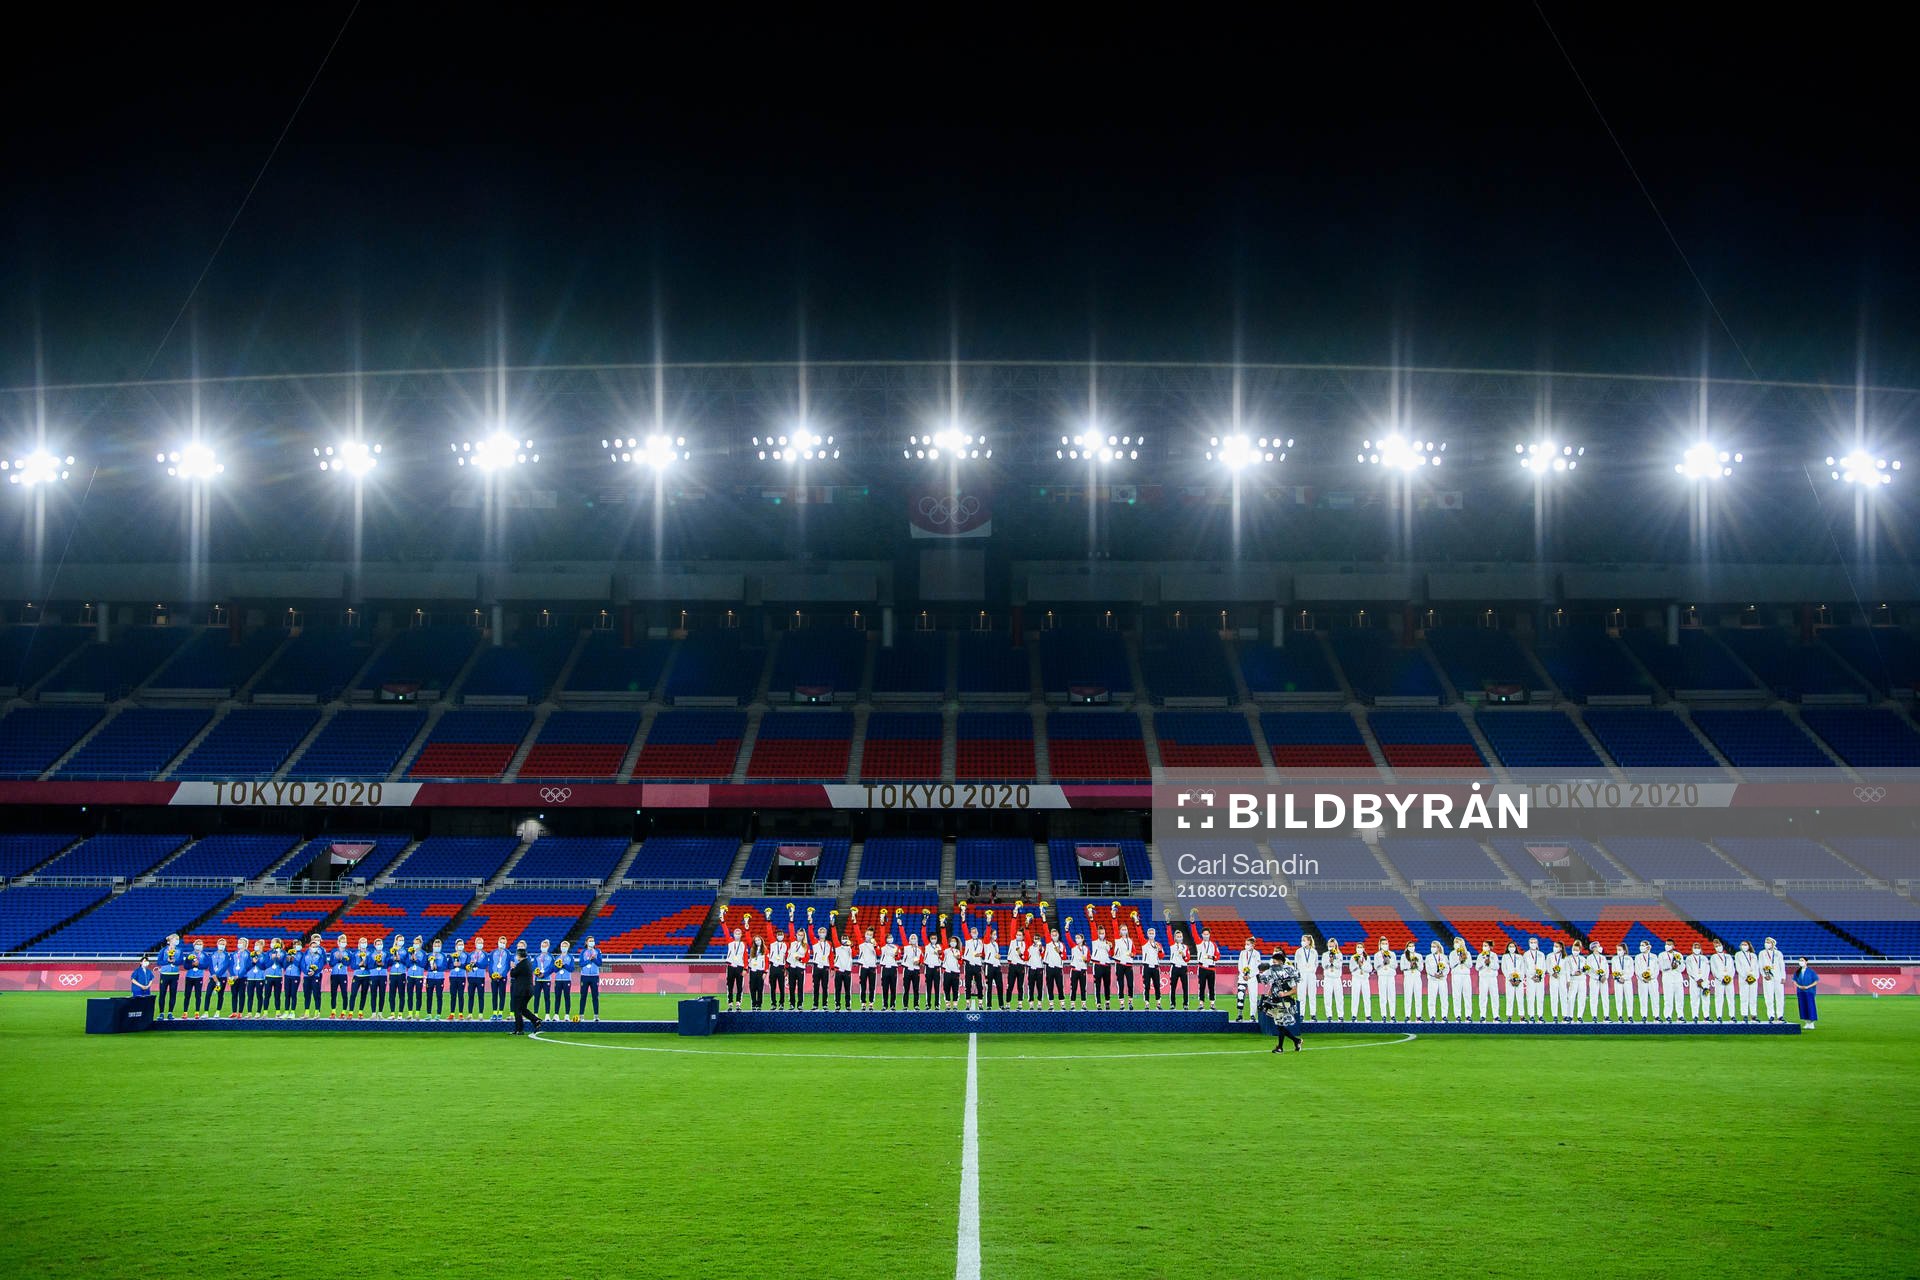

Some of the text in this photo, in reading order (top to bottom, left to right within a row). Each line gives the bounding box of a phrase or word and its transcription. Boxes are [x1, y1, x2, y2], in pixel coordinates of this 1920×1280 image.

[213, 782, 383, 806] TOKYO 2020
[863, 784, 1030, 808] TOKYO 2020
[1527, 784, 1699, 808] TOKYO 2020
[615, 978, 635, 986] 2020
